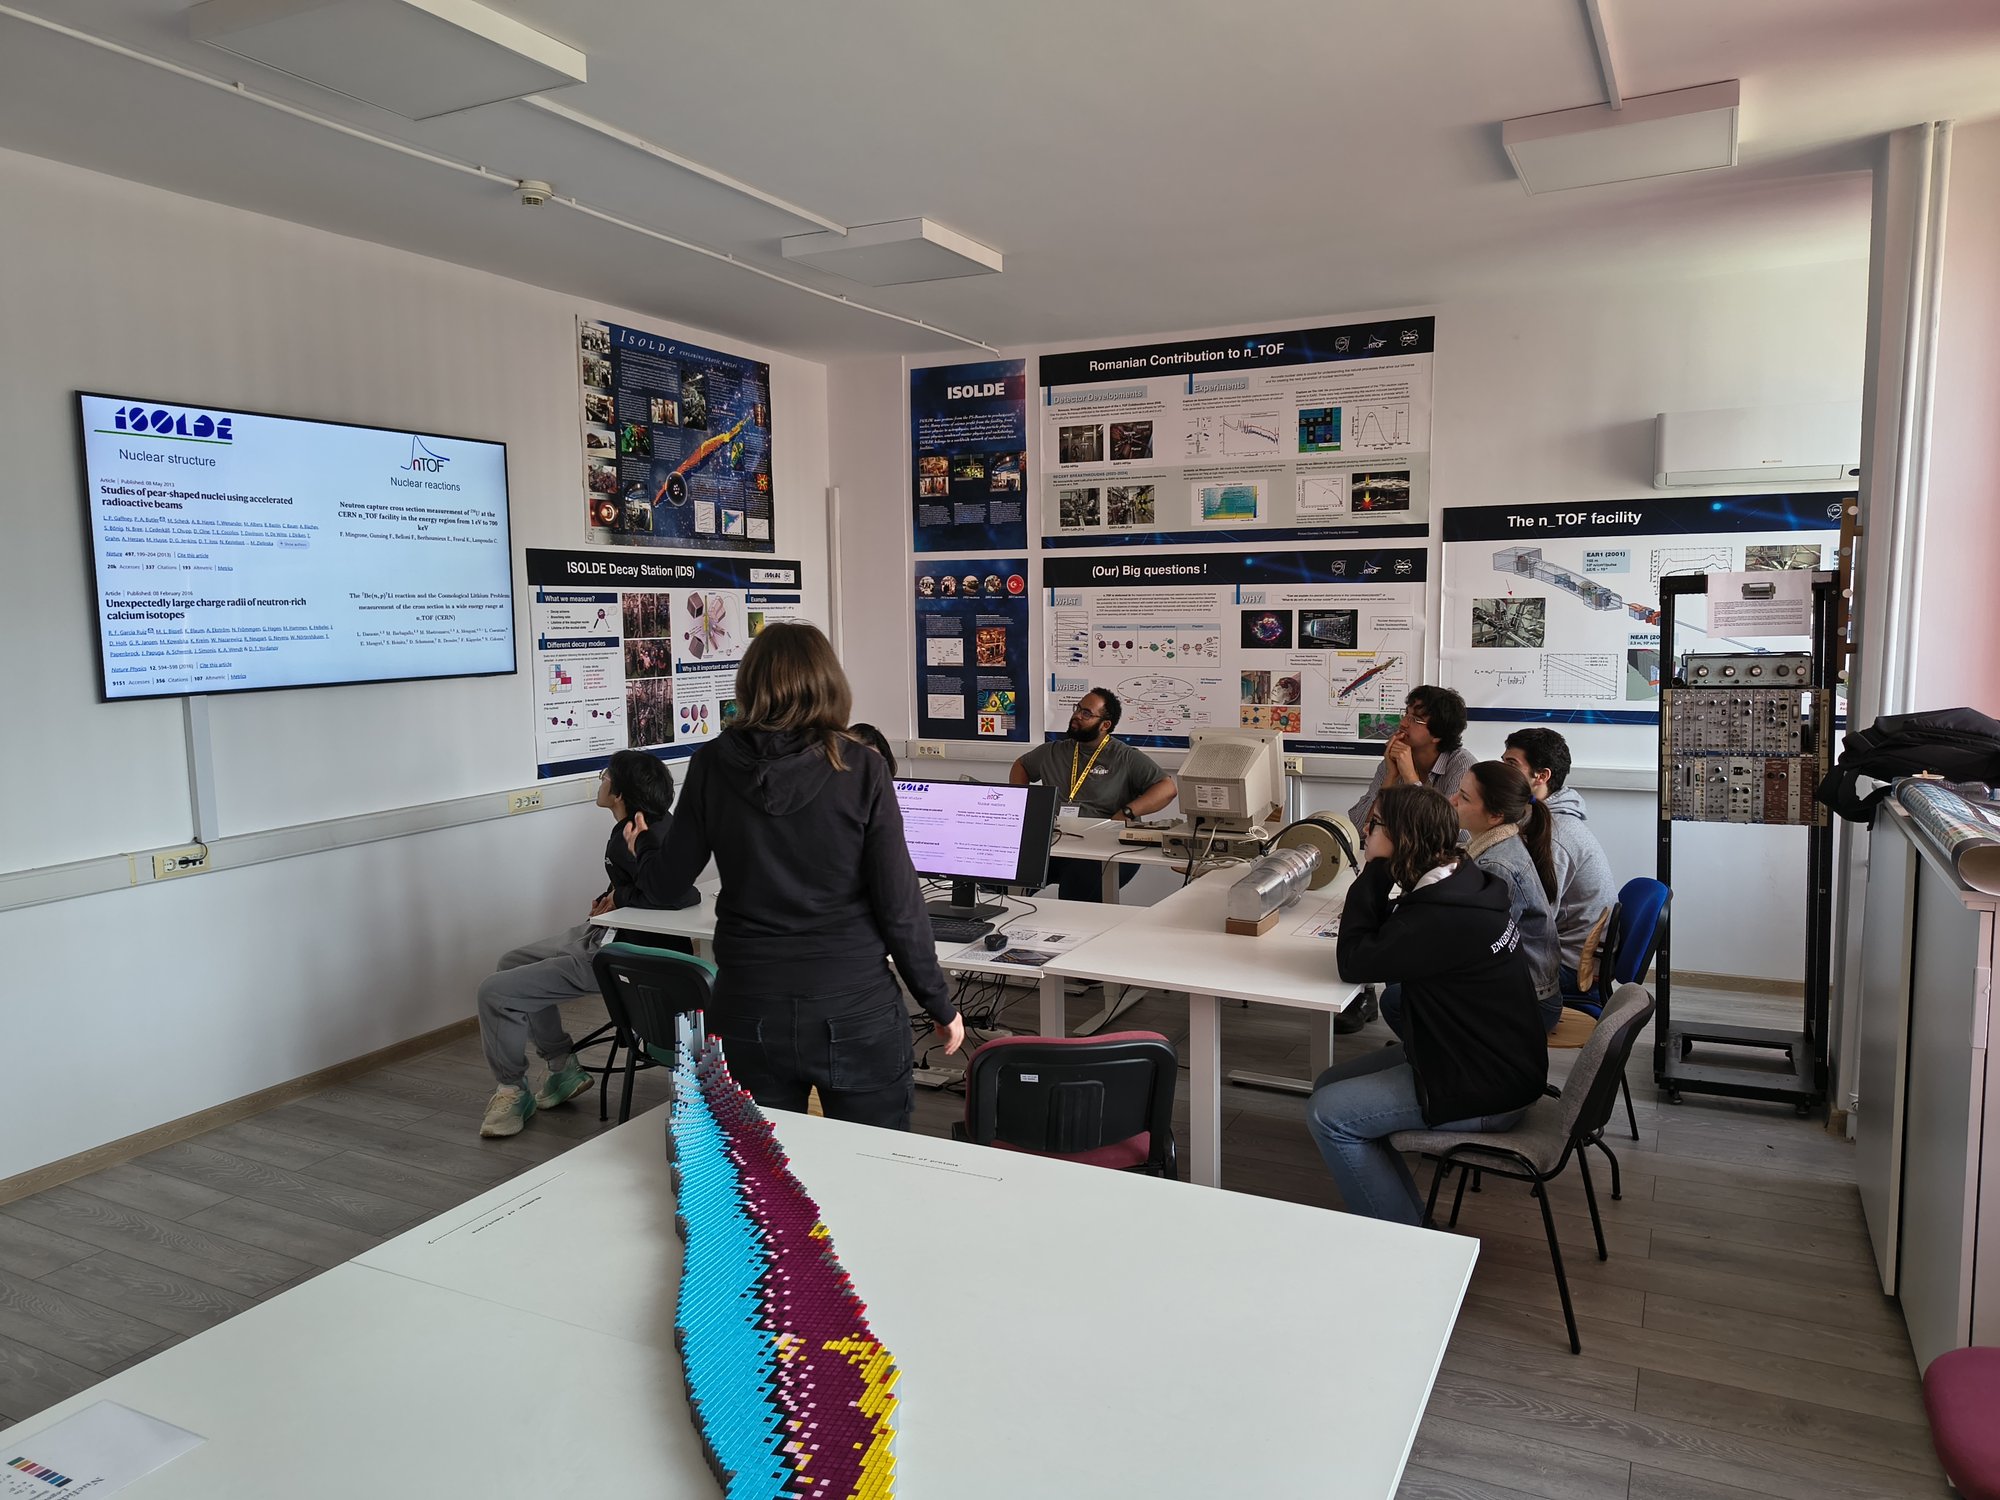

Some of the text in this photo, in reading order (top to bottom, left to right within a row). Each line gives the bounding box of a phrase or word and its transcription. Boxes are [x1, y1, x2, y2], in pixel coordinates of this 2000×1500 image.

[1089, 342, 1285, 372] Romanian Contribution to n_TOF
[947, 382, 1005, 400] ISOLDE
[1194, 382, 1246, 395] Experiments
[1054, 390, 1143, 405] Detector Developments
[119, 449, 216, 467] Nuclear structure
[391, 476, 461, 492] Nuclear reactions
[101, 485, 293, 505] Studies of pear-shaped nuclei using accelerated
[102, 498, 183, 510] radioactive beams
[339, 501, 366, 509] Neutron
[379, 513, 399, 521] facility
[1507, 511, 1642, 528] The n_TOF facility
[567, 560, 696, 579] ISOLDE Decay Station (IDS)
[1092, 563, 1207, 578] (Our) Big questions !
[105, 597, 307, 610] Unexpectedly large charge radii of neutron-rich
[569, 595, 596, 603] measure?
[1055, 597, 1078, 606] WHAT
[1241, 594, 1262, 604] WHY
[107, 610, 186, 621] calcium isotopes
[435, 614, 456, 622] (CERN)
[546, 641, 571, 649] Different
[571, 641, 588, 649] decay
[701, 663, 721, 671] important
[1056, 683, 1084, 691] WHERE
[57, 1476, 105, 1500] Nuclid
